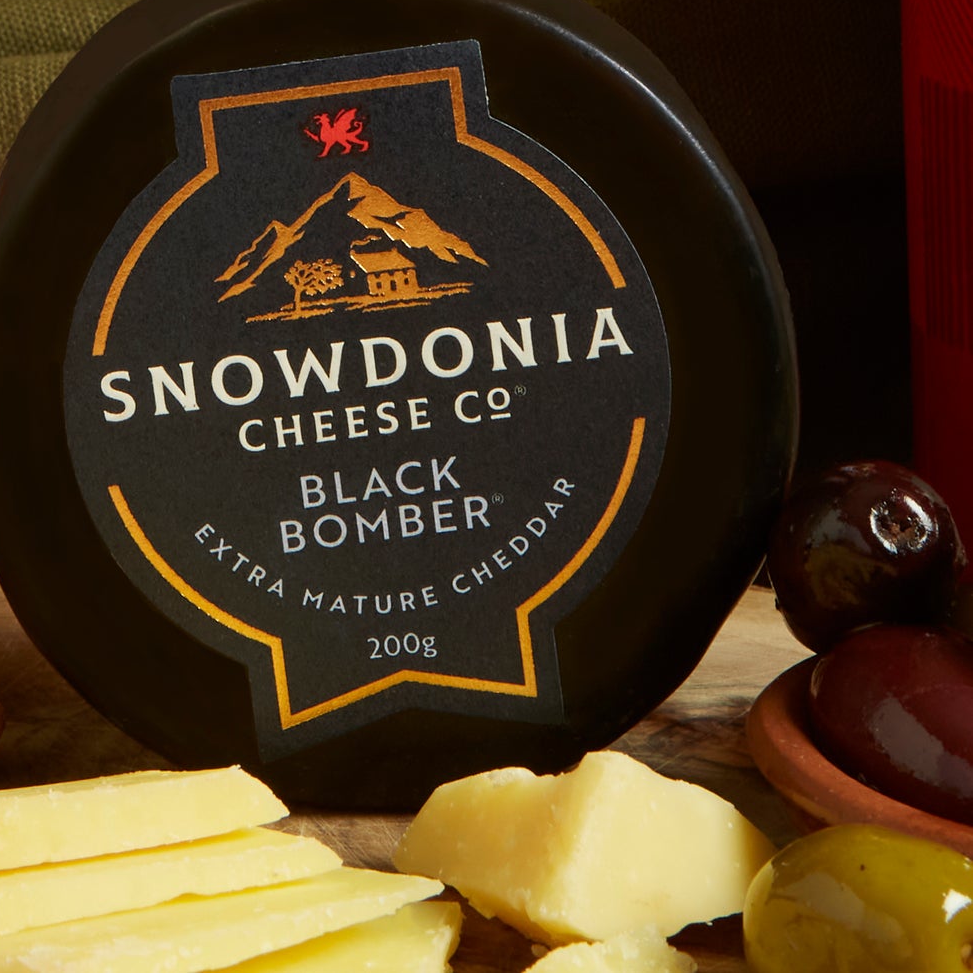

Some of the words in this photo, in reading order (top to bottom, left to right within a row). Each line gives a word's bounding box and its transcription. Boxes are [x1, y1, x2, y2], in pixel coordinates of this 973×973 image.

[100, 307, 634, 423] SNOWDONIA
[238, 397, 431, 452] CHEESE
[300, 456, 461, 509] BLACK
[194, 523, 285, 599] EXTRA
[303, 586, 439, 615] MATURE
[451, 477, 576, 594] CHEDDAR
[367, 632, 438, 659] 200g
